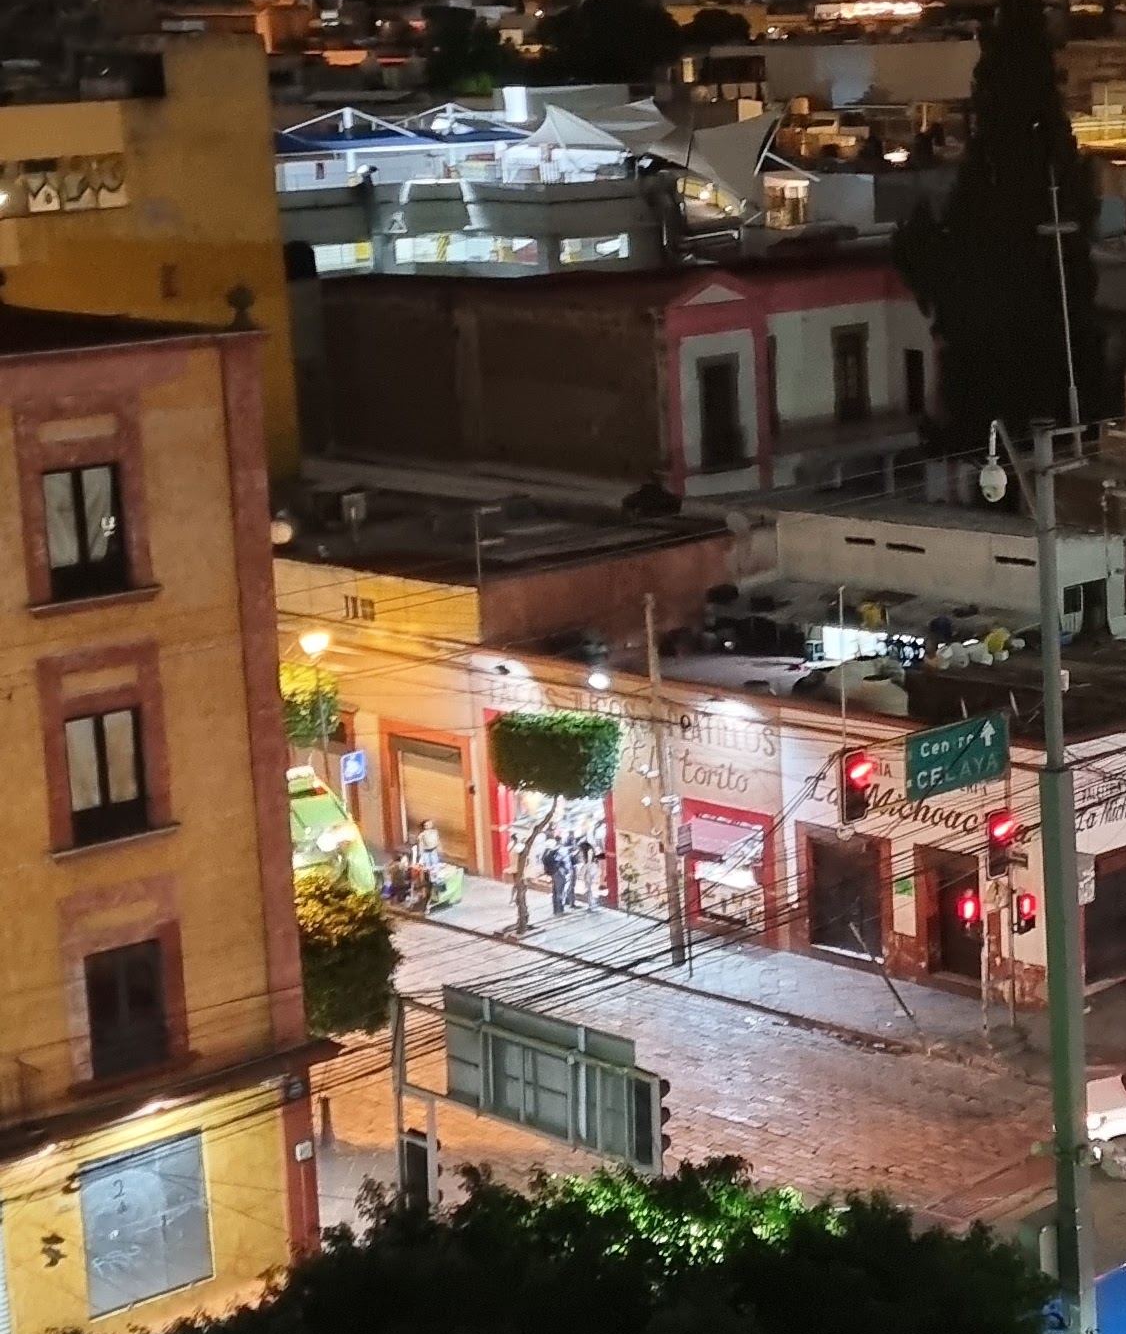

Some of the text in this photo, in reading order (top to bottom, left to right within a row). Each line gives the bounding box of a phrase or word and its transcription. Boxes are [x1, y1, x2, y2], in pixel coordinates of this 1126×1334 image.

[920, 733, 974, 758] Cenro
[679, 747, 749, 794] torito
[863, 781, 1032, 845] Michoaca
